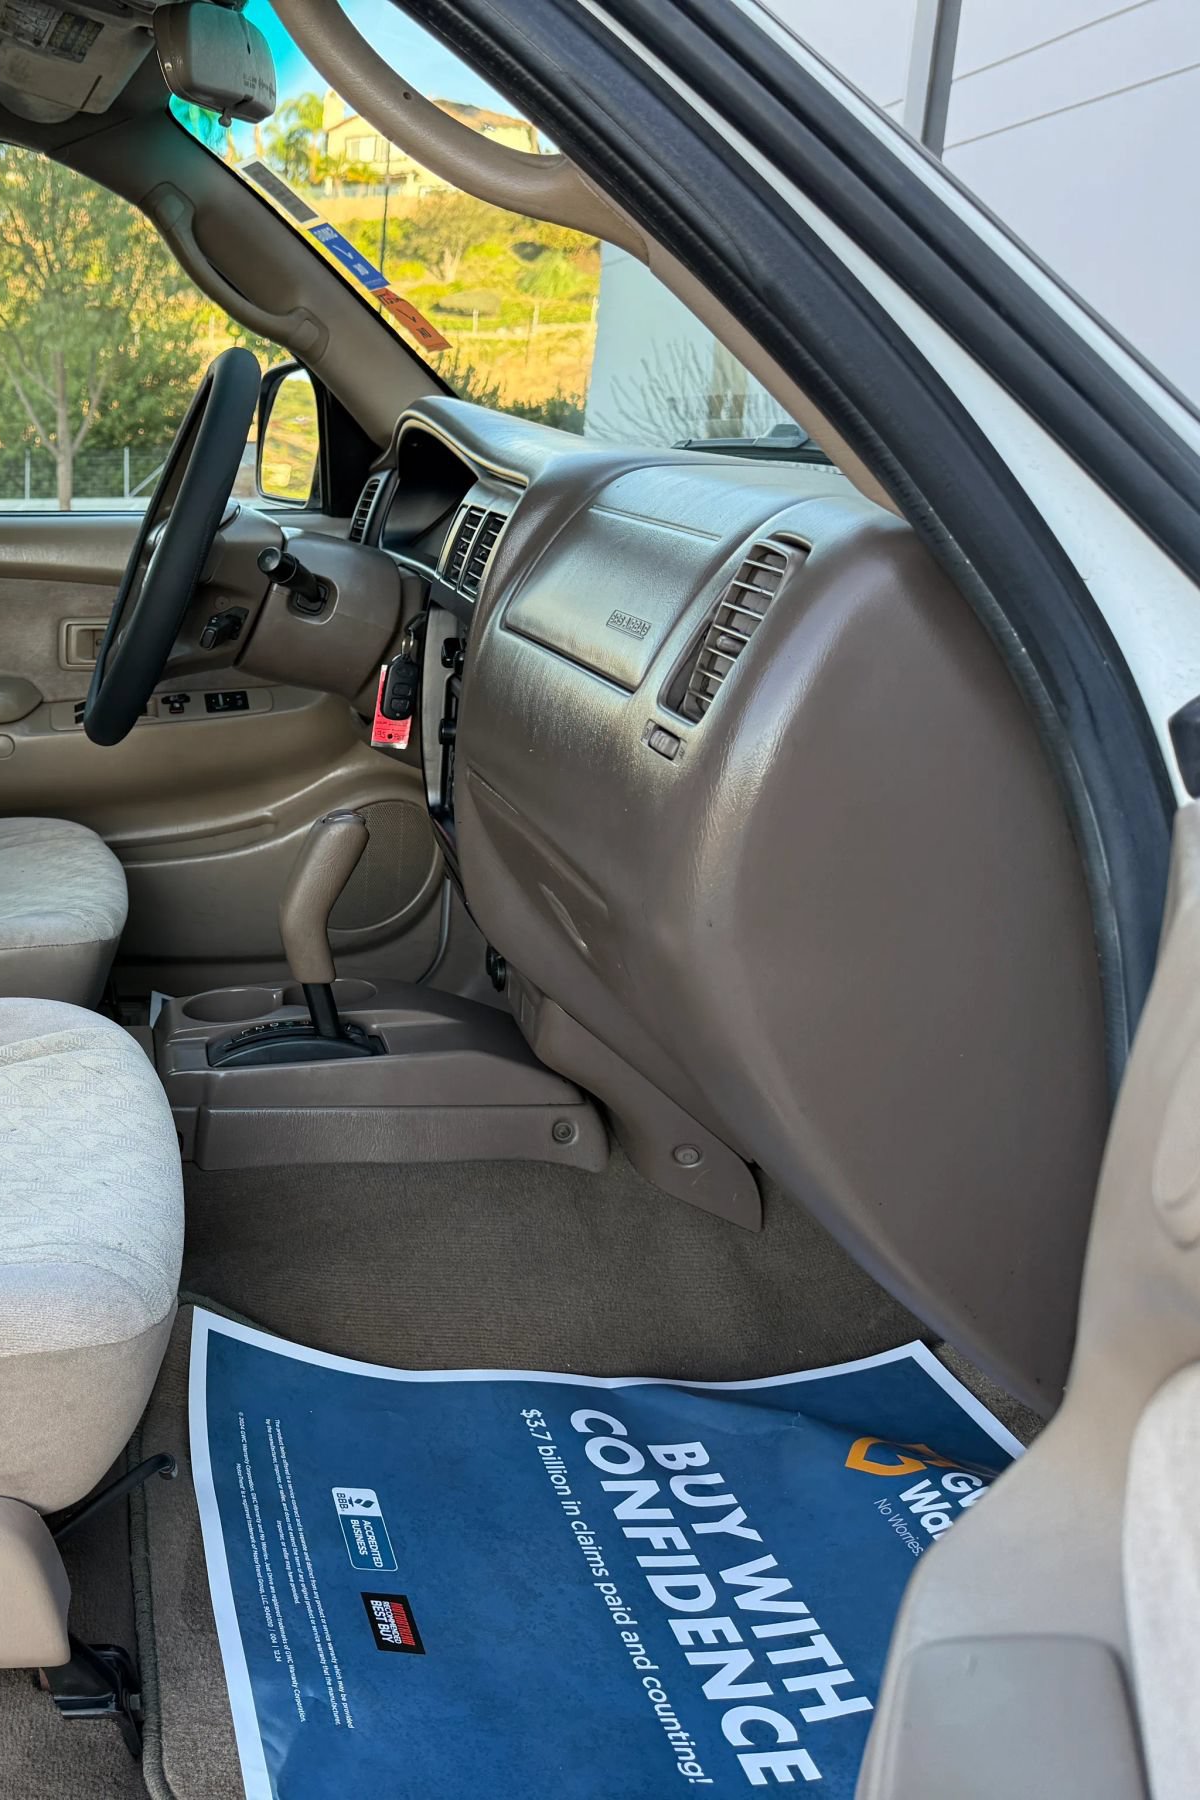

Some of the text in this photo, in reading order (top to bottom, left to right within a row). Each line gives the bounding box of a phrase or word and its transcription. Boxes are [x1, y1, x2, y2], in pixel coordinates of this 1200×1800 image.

[873, 1498, 892, 1515] No
[350, 1519, 368, 1556] BUSINESS
[362, 1519, 383, 1568] ACCREDITED
[520, 1407, 714, 1784] $3.7 billion in claims paid and counting!
[570, 1408, 823, 1786] CONFIDENCE
[647, 1441, 874, 1723] BUY WITH
[370, 1600, 395, 1644] BEST BUY
[382, 1601, 402, 1644] RECOMMENDED
